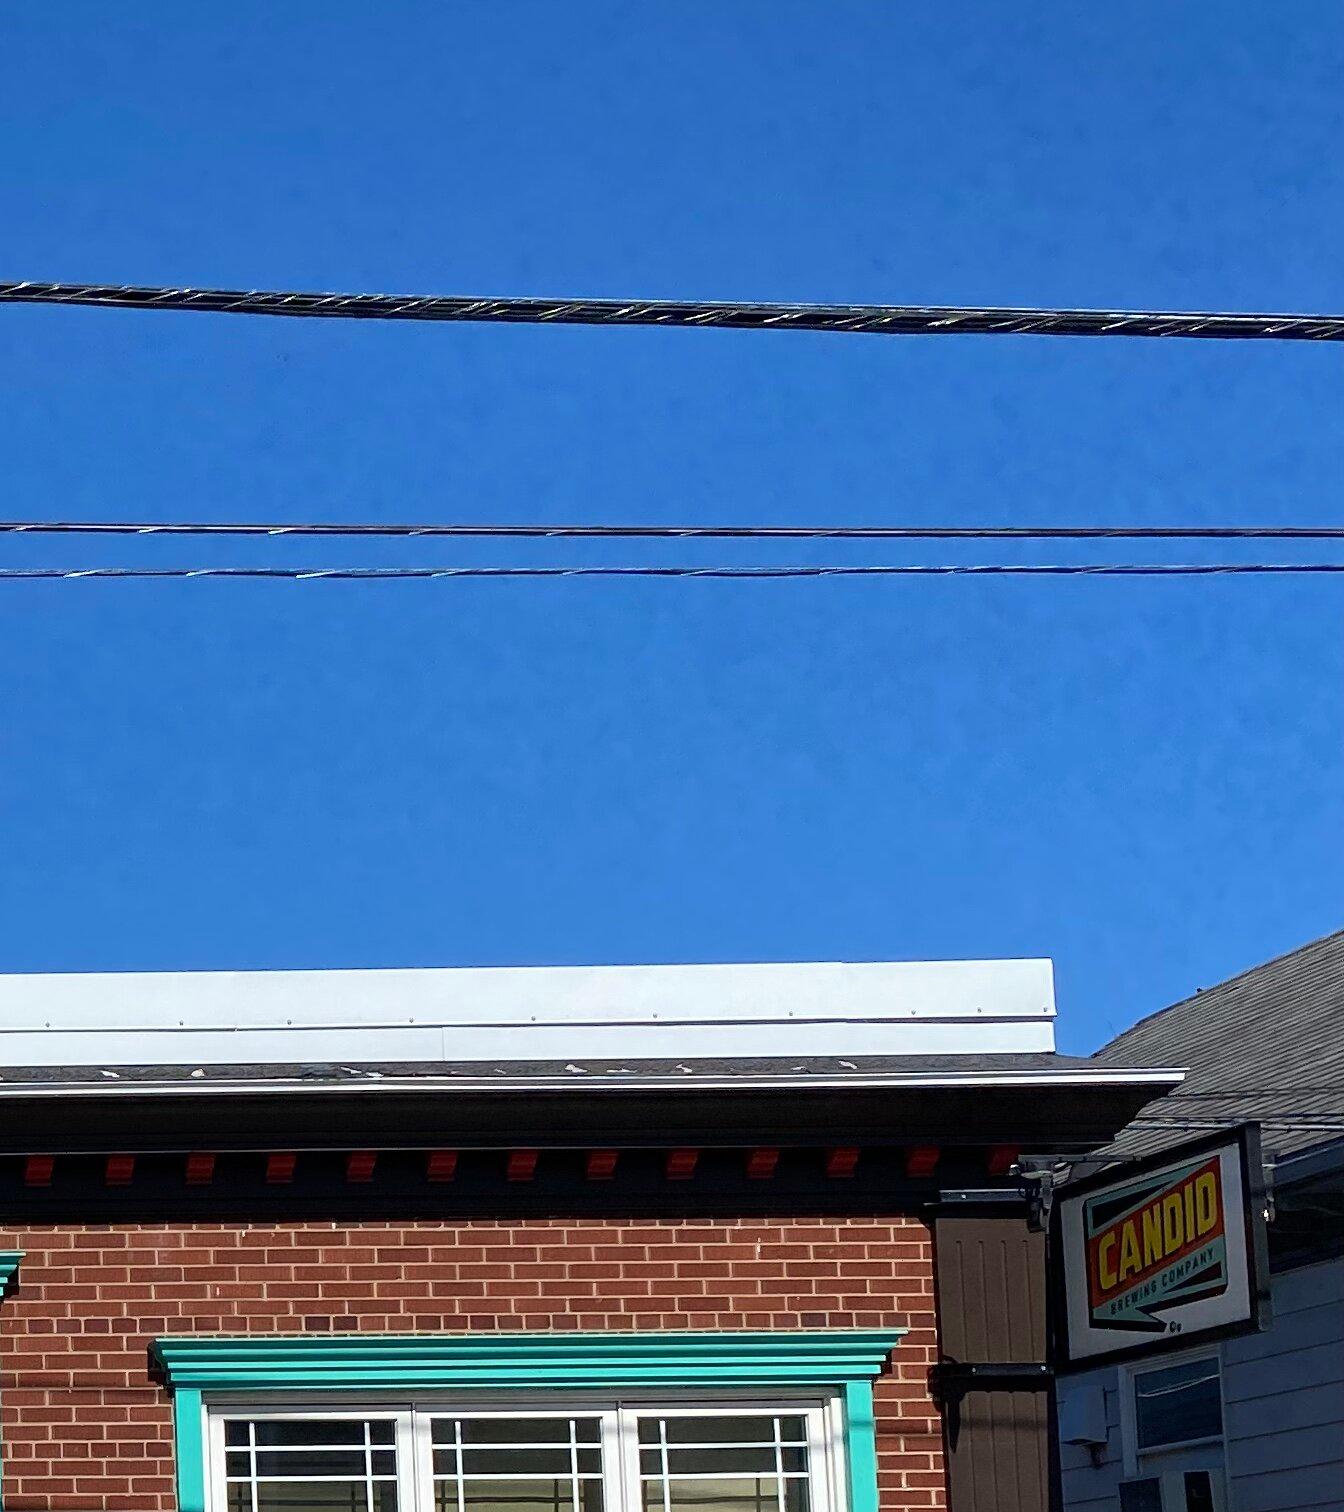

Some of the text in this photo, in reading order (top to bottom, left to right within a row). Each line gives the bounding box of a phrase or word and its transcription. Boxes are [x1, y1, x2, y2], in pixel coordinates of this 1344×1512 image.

[1098, 1171, 1217, 1290] CANDID
[1110, 1247, 1214, 1316] BREWING COMPANY
